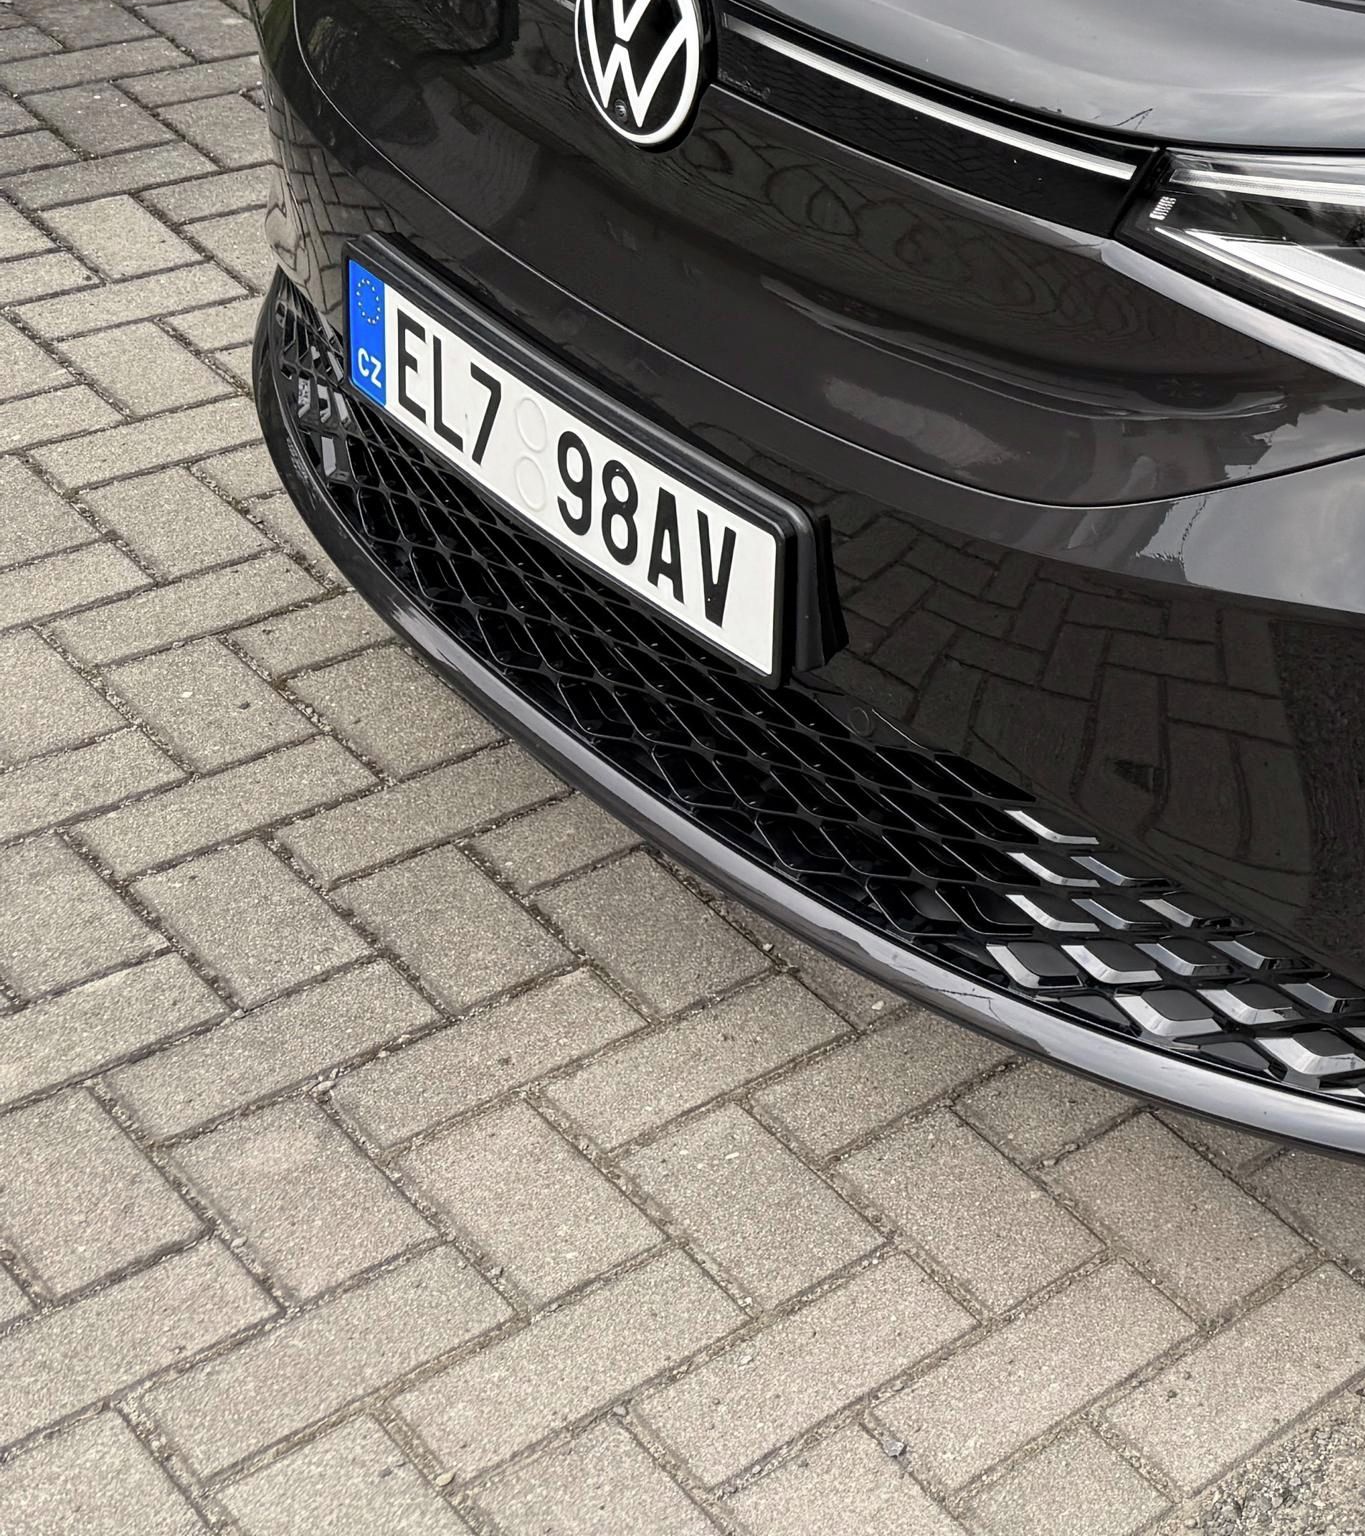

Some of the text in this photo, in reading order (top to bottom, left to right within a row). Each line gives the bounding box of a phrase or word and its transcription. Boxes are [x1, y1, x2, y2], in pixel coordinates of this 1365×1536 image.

[357, 347, 382, 389] CZ
[397, 307, 737, 629] EL7 98AV
